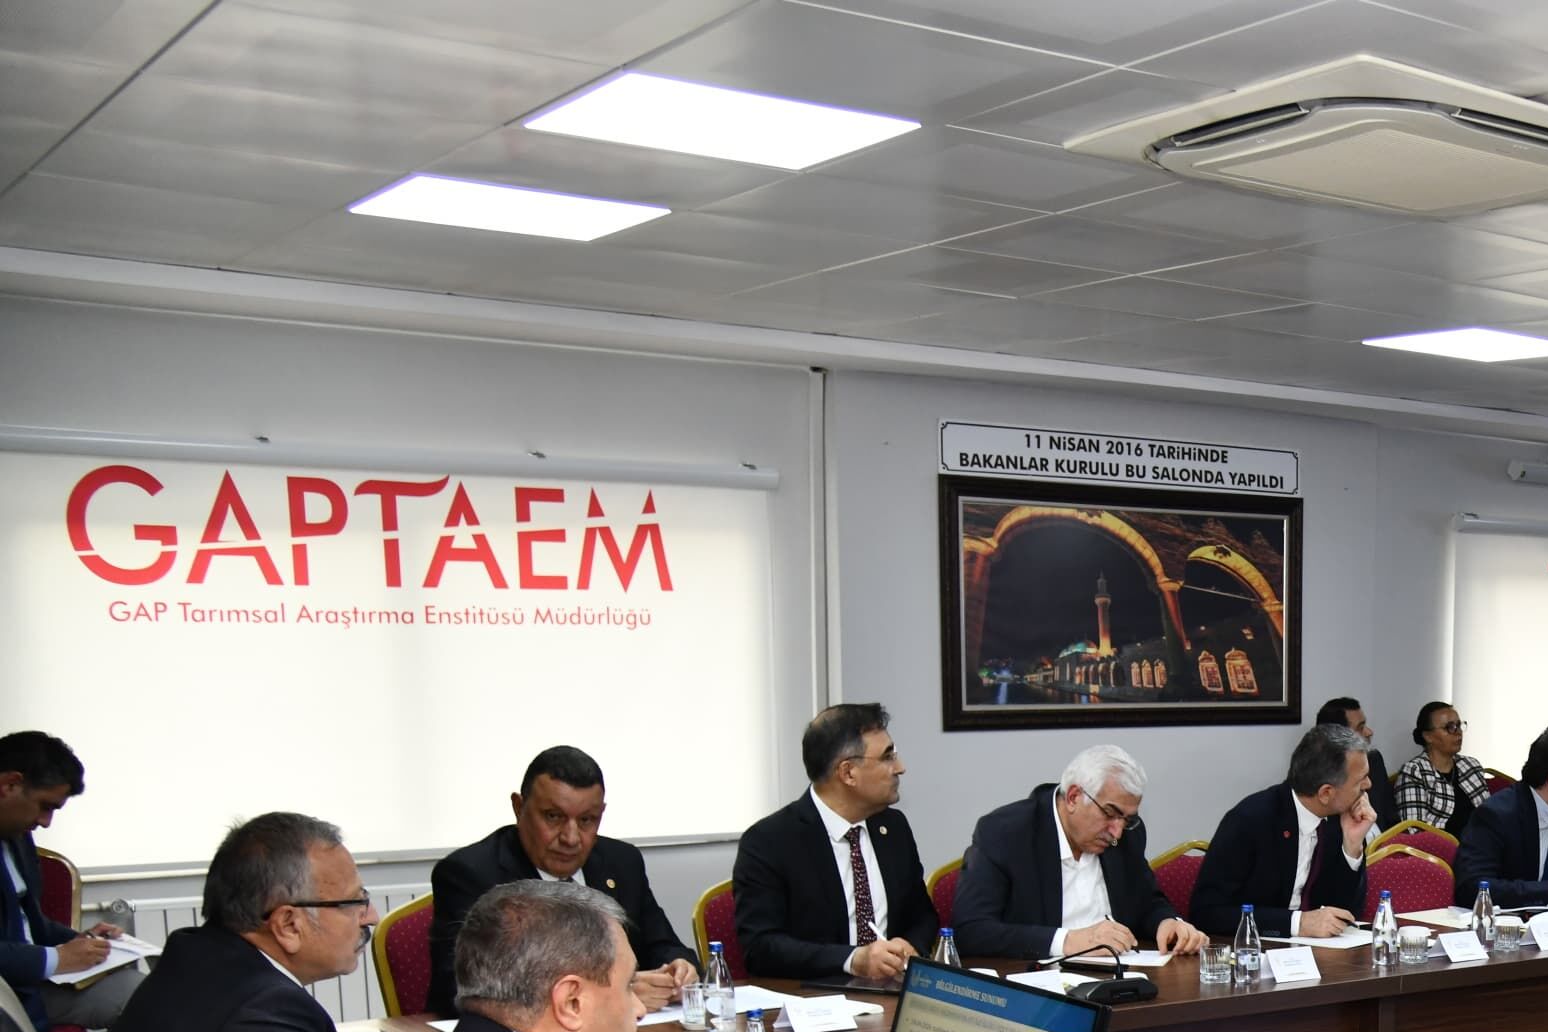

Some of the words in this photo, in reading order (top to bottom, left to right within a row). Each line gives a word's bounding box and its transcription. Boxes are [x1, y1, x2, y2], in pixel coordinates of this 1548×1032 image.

[1024, 434, 1041, 449] 11
[1106, 440, 1143, 456] 2016
[959, 452, 1049, 472] BAKANLAR
[1055, 459, 1120, 477] KURULU
[1125, 463, 1147, 479] BU
[1151, 467, 1225, 485] SALONDA
[1228, 471, 1285, 489] YAPILDI
[66, 464, 674, 593] GAPTAEM
[108, 602, 168, 623] GAP
[180, 602, 286, 624] Tarımsal
[296, 604, 415, 630] Araştırma
[426, 605, 524, 626] Enstitüsü
[534, 606, 652, 631] Müdürlüğü
